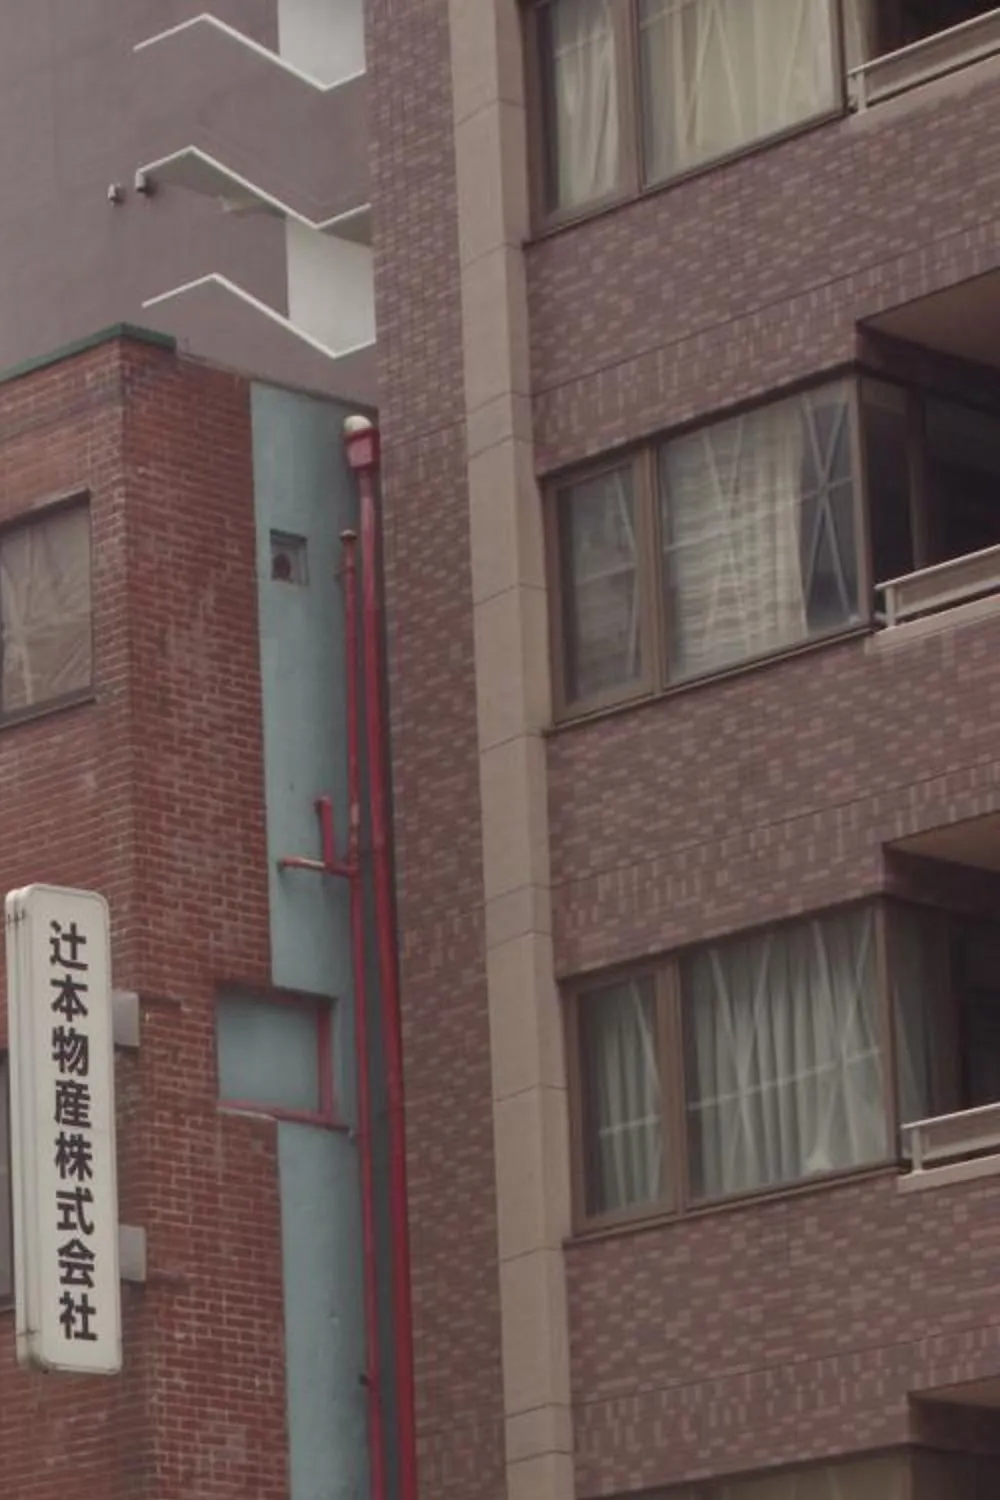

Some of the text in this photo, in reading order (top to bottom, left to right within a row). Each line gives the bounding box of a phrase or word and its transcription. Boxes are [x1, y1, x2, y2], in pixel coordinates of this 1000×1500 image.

[49, 921, 98, 1341] 辻本物産株式会社
